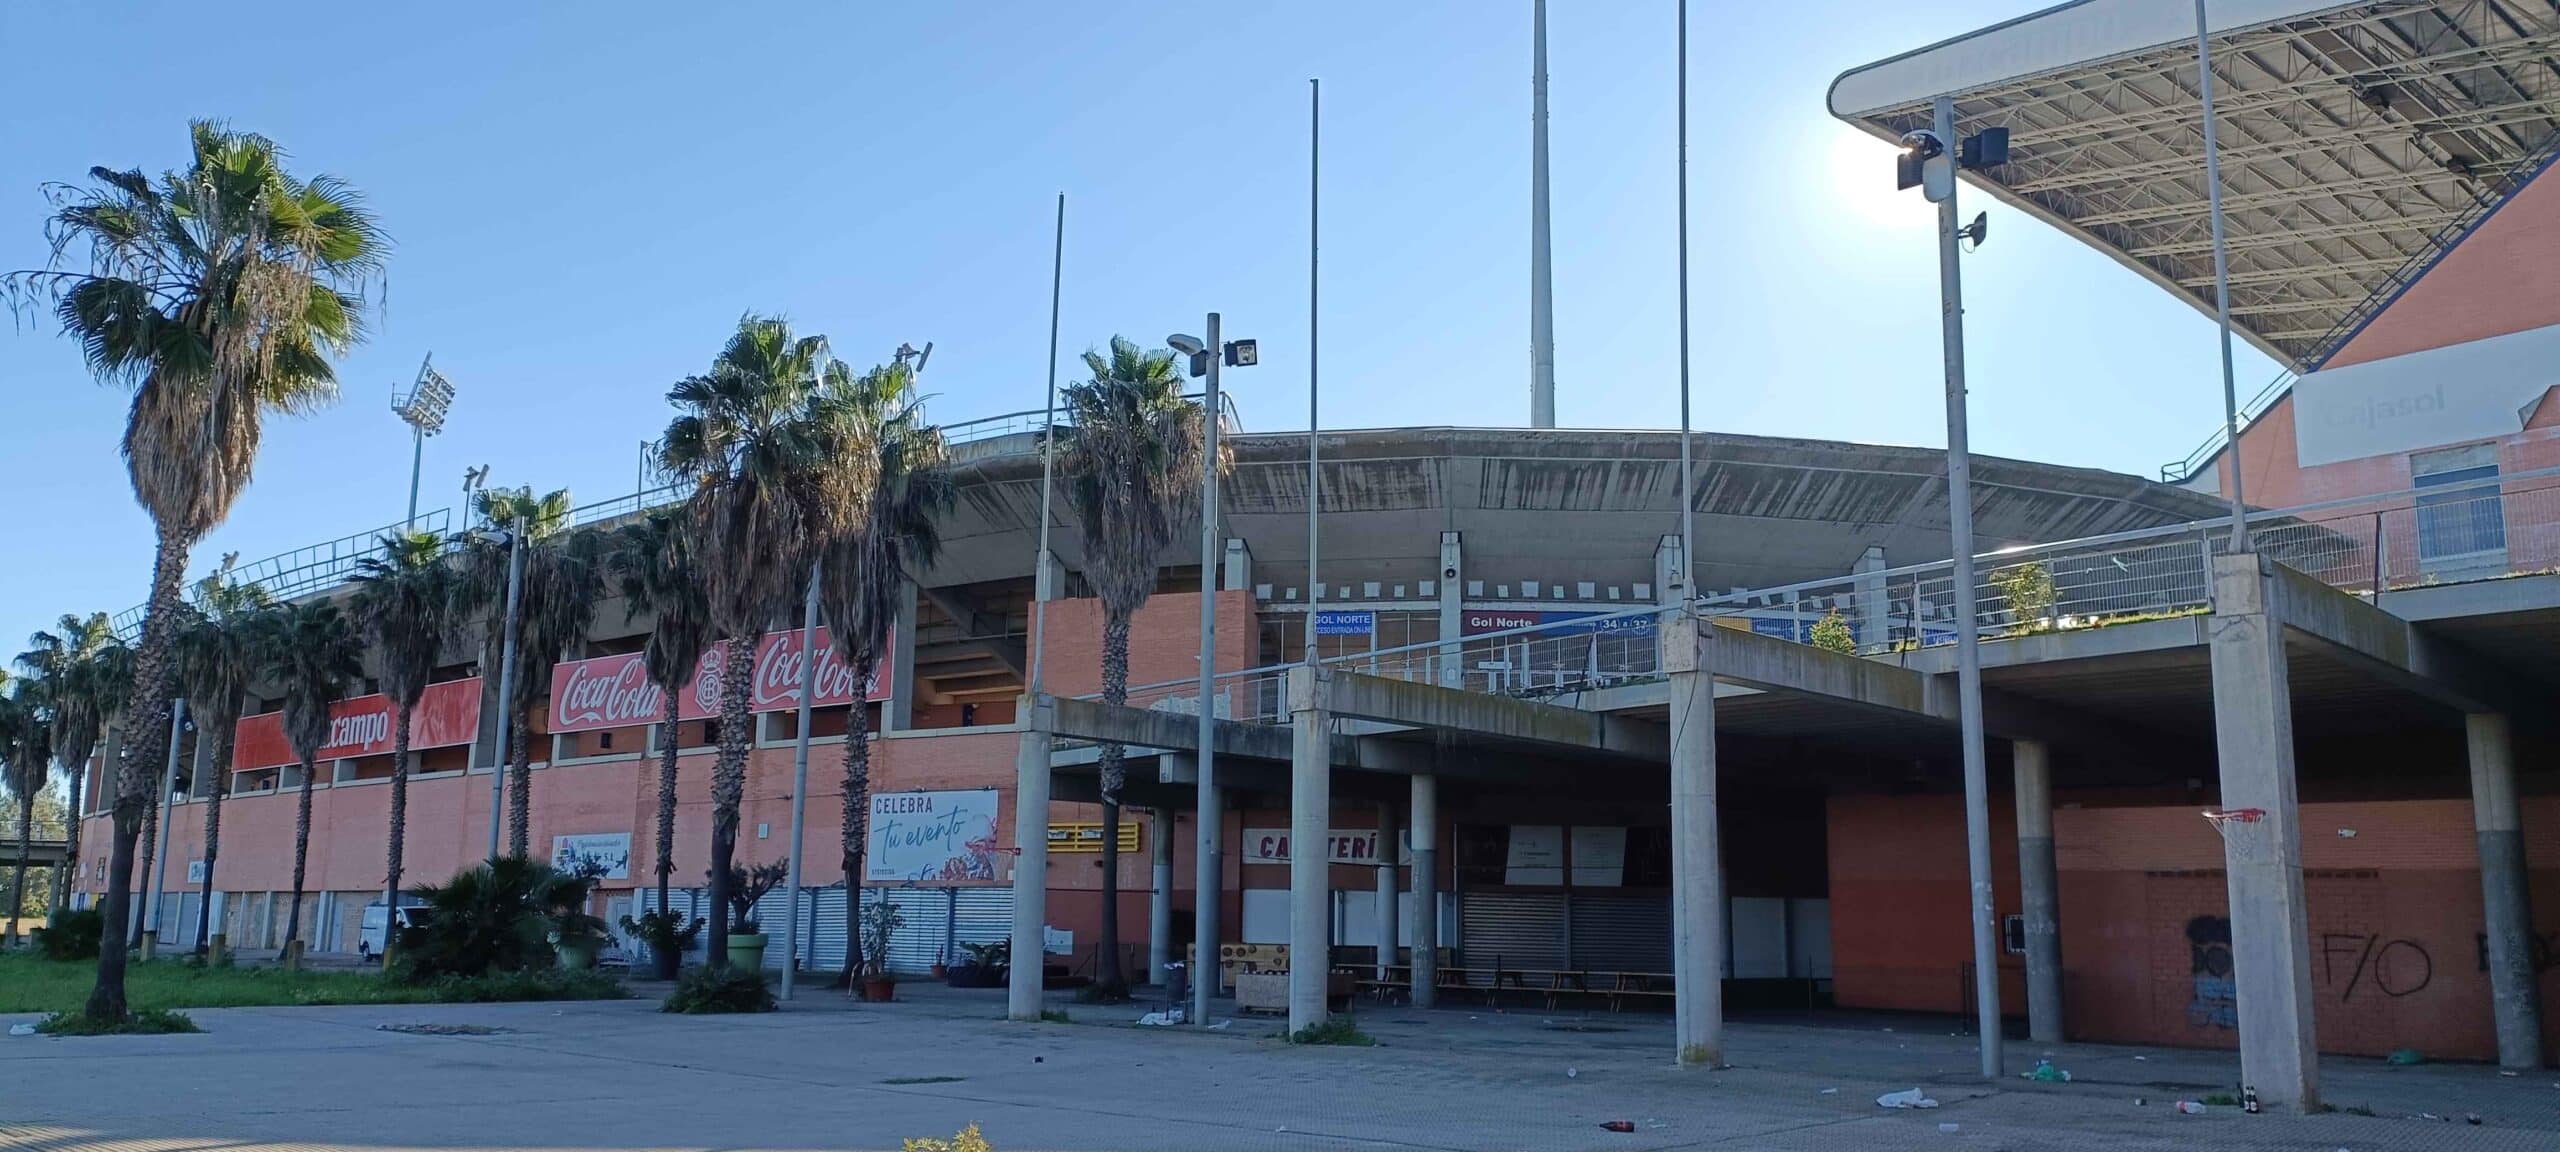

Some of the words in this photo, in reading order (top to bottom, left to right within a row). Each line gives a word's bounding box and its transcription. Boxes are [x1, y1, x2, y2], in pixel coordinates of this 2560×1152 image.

[1336, 615, 1371, 624] NORTE
[1471, 617, 1492, 628] Gol
[1496, 617, 1533, 628] Norte
[1602, 619, 1618, 629] 34
[319, 710, 389, 751] campo
[875, 797, 932, 815] CELEBRA
[905, 804, 968, 852] evento
[2320, 932, 2432, 1001] F/O
